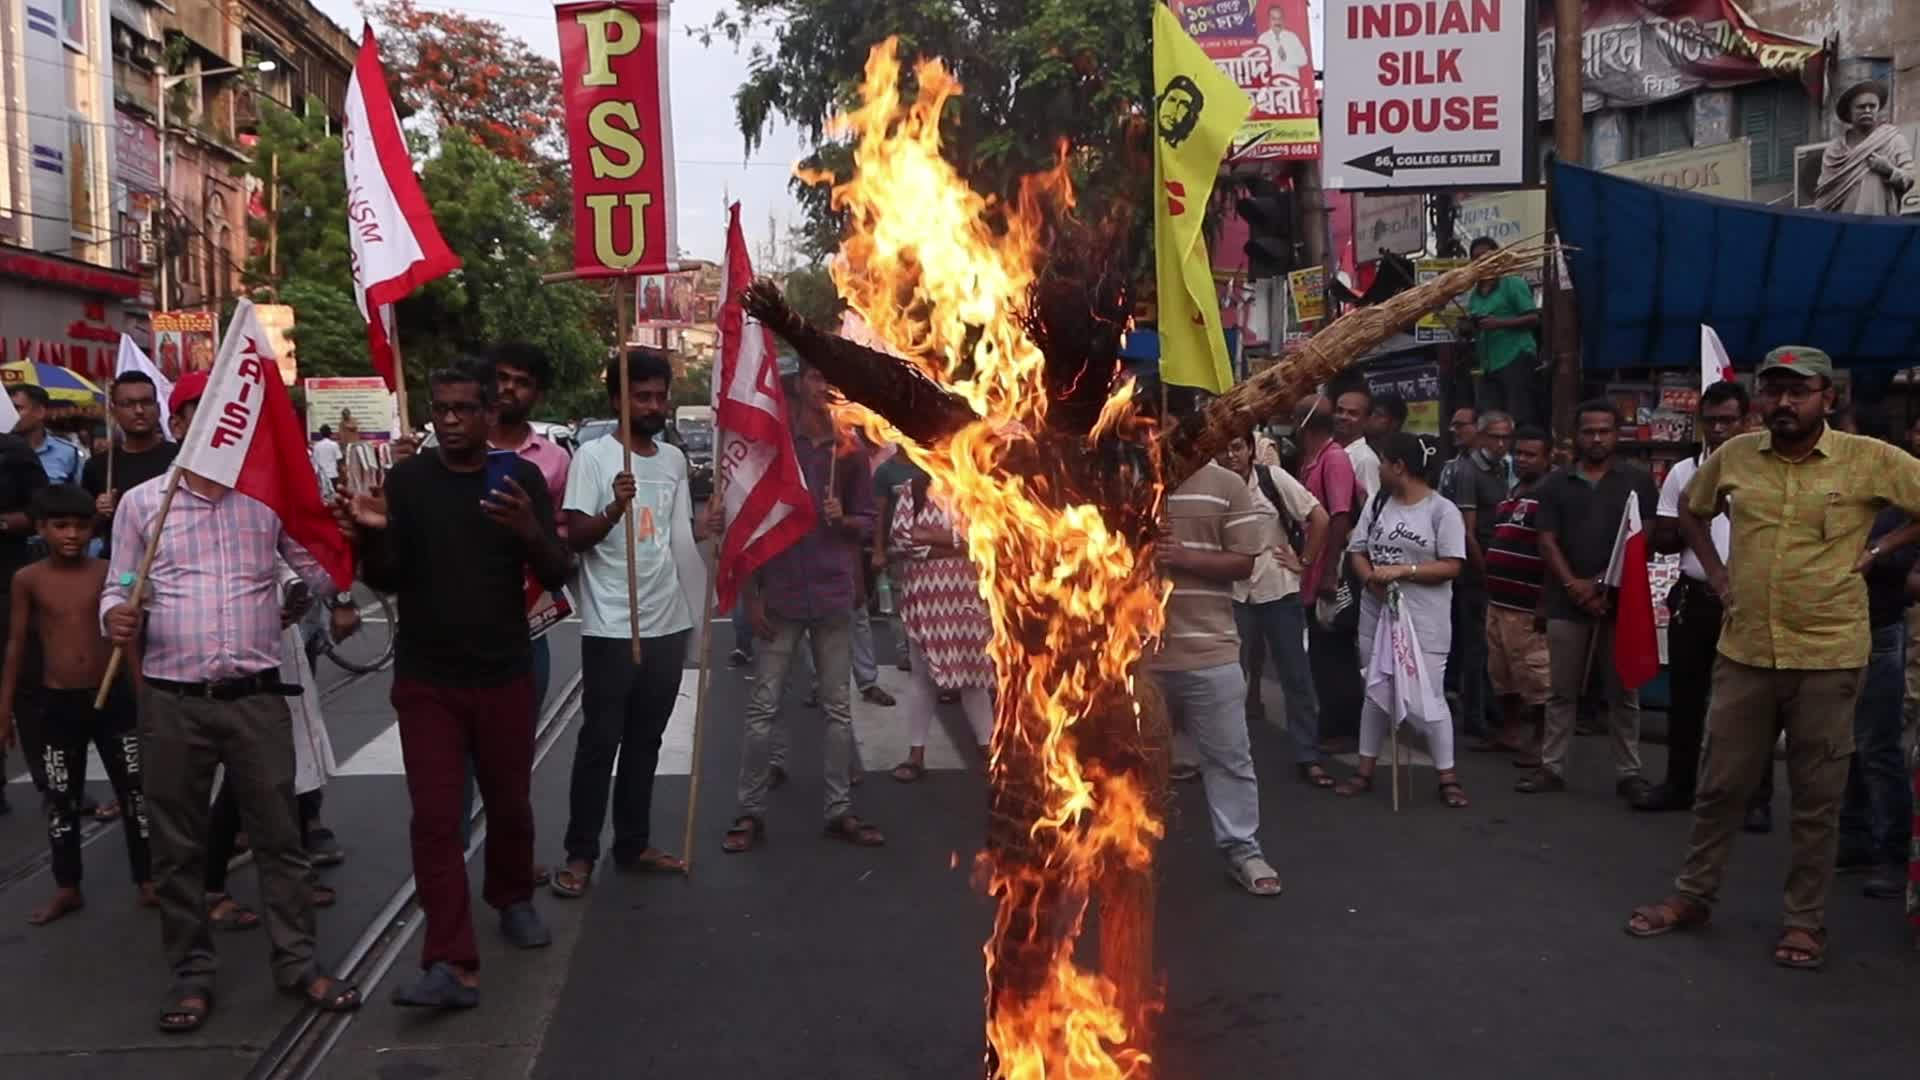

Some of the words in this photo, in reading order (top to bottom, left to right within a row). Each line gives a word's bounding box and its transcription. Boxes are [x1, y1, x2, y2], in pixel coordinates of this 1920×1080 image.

[1347, 0, 1500, 39] INDIAN
[1378, 49, 1463, 86] SILK
[1347, 96, 1499, 135] HOUSE
[577, 8, 651, 270] PSU
[1396, 155, 1448, 166] COLLEGE
[1450, 153, 1494, 164] STREET
[210, 358, 262, 449] AISF
